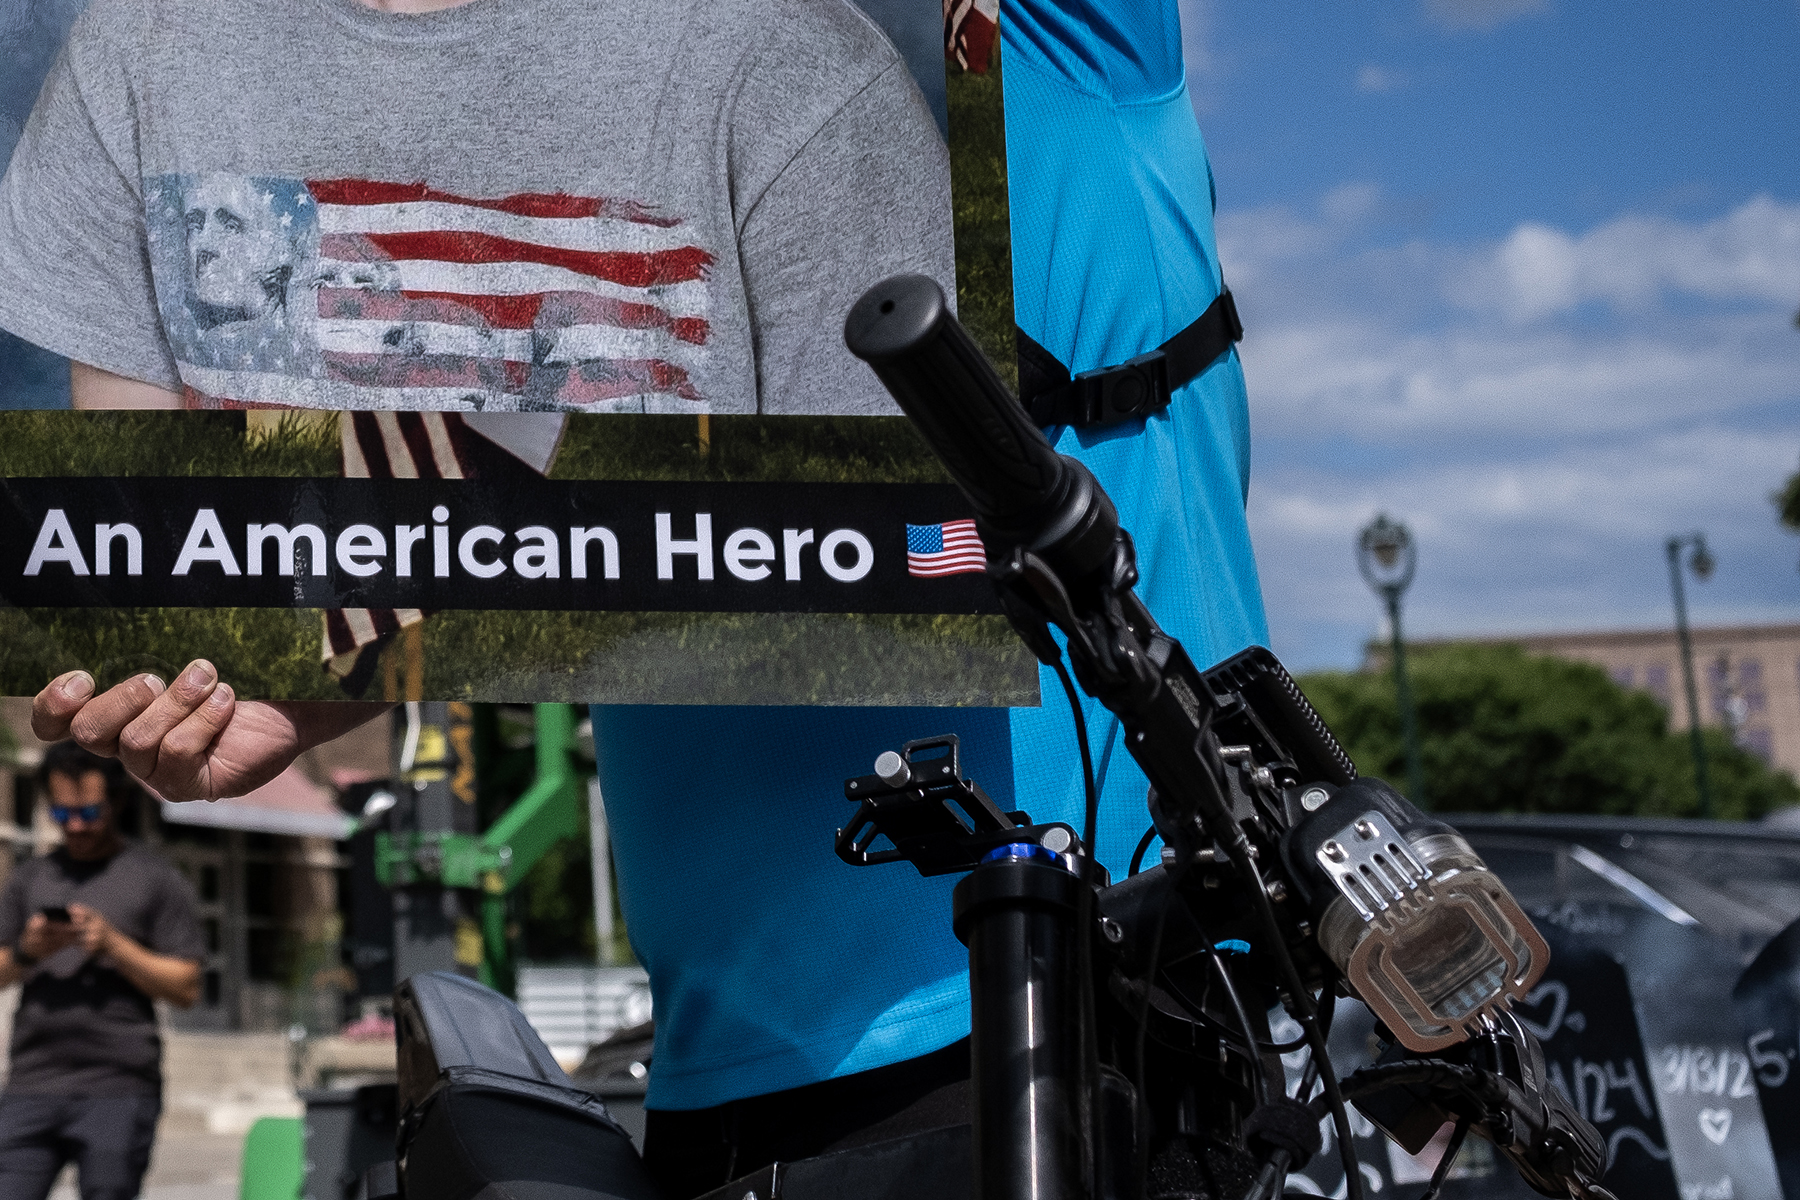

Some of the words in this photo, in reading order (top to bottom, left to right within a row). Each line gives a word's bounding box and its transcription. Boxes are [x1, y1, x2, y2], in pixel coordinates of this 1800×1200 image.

[22, 508, 144, 576] An
[170, 504, 621, 580] American
[654, 511, 875, 583] Hero
